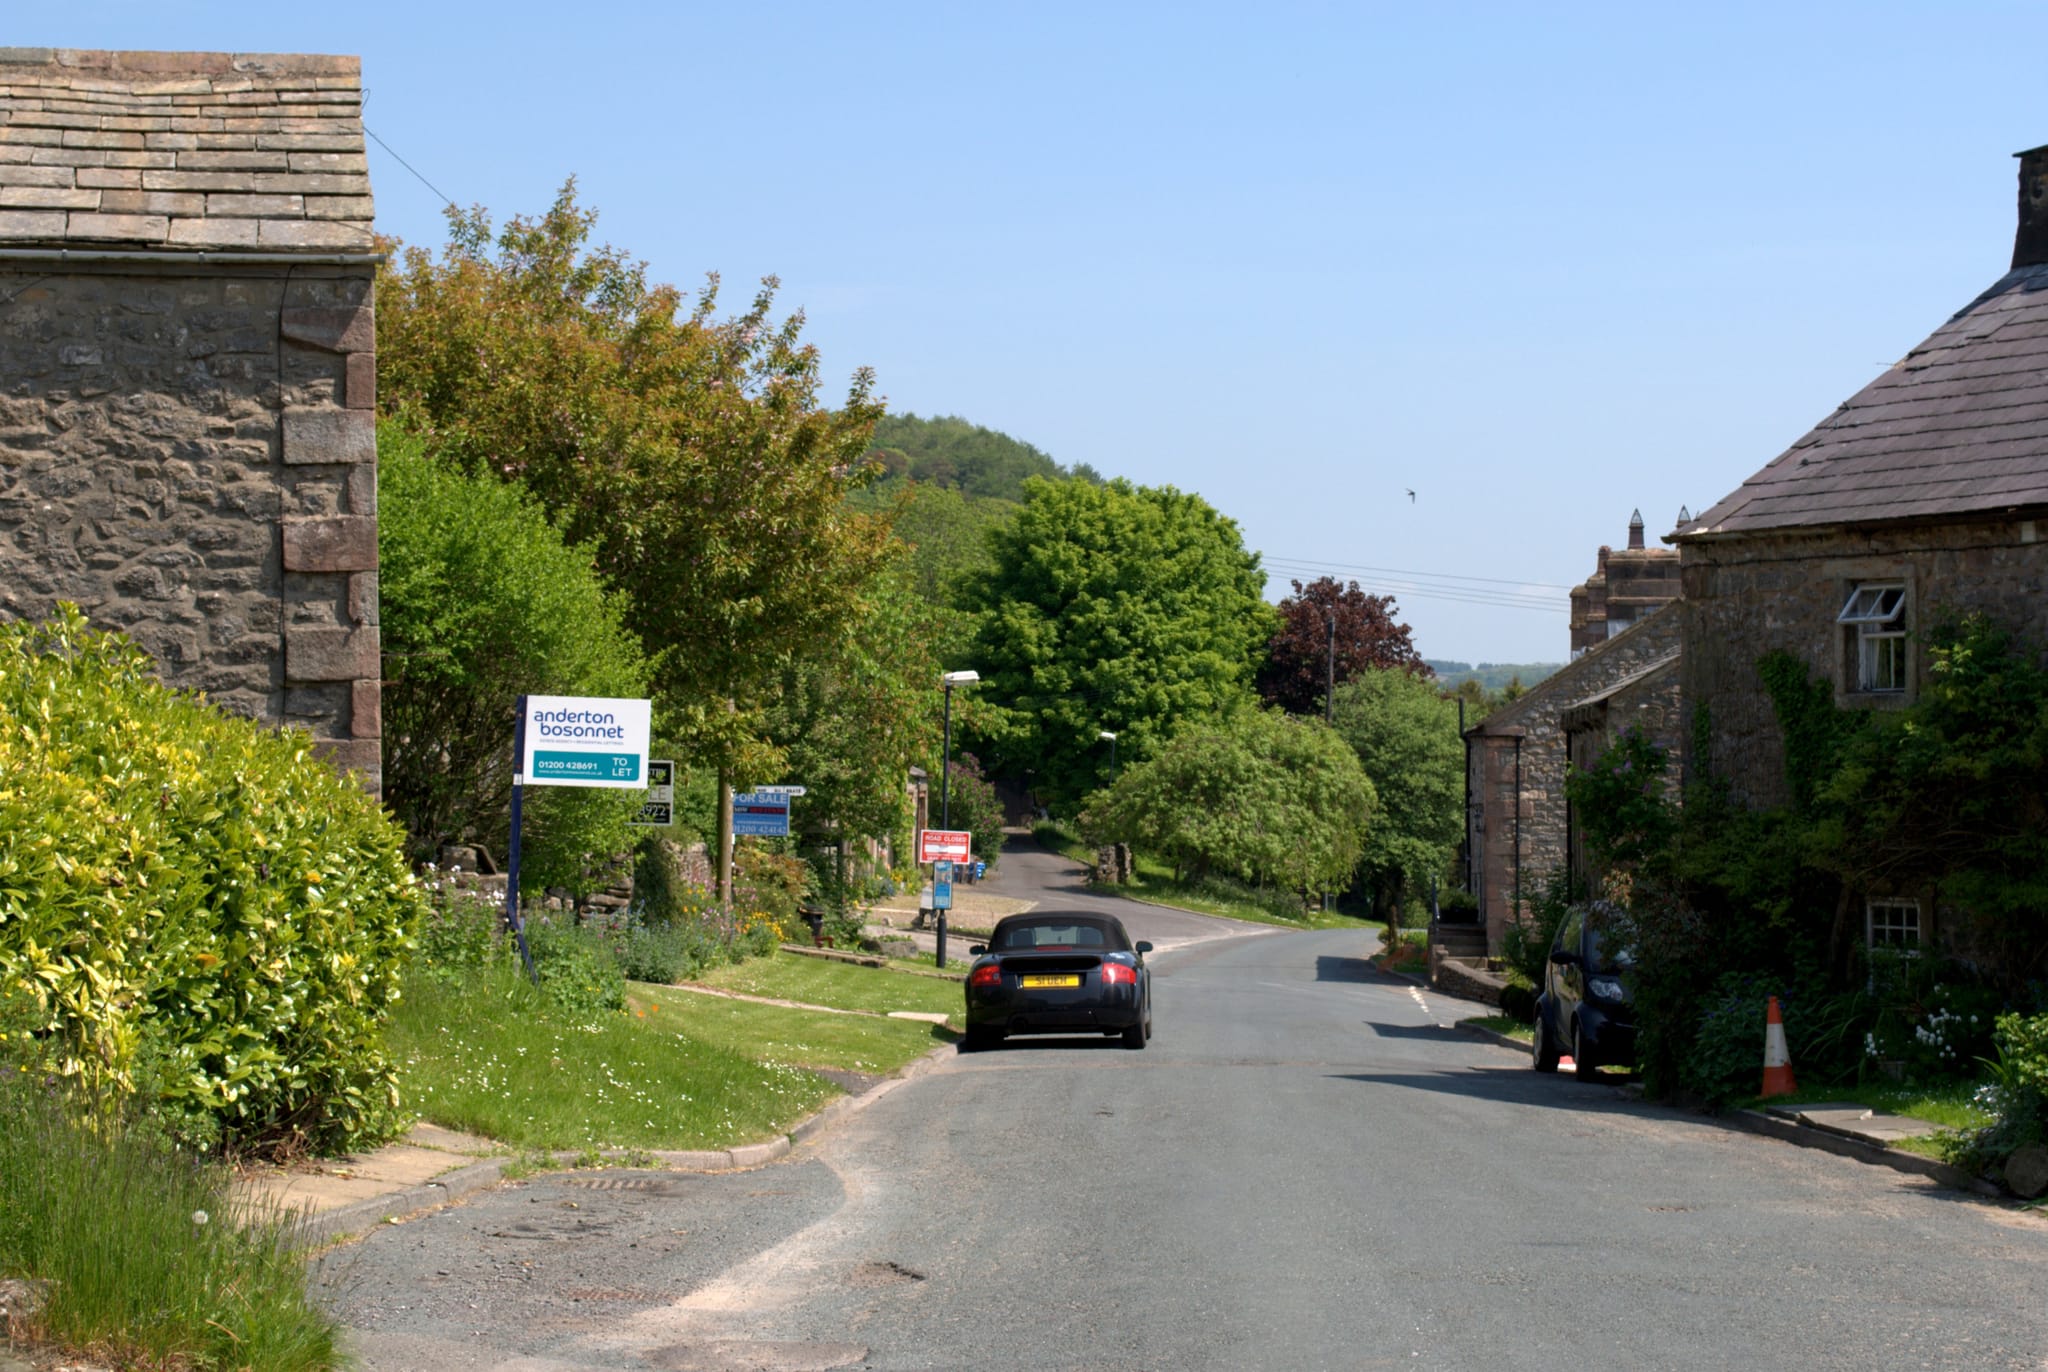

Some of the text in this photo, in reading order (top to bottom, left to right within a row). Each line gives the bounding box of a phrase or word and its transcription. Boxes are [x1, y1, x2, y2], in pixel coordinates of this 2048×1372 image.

[534, 708, 614, 724] anderton
[540, 723, 624, 739] bosonnet
[538, 760, 598, 770] 01200 428691
[612, 757, 628, 766] TO
[612, 768, 632, 777] LET
[758, 794, 787, 804] SALE
